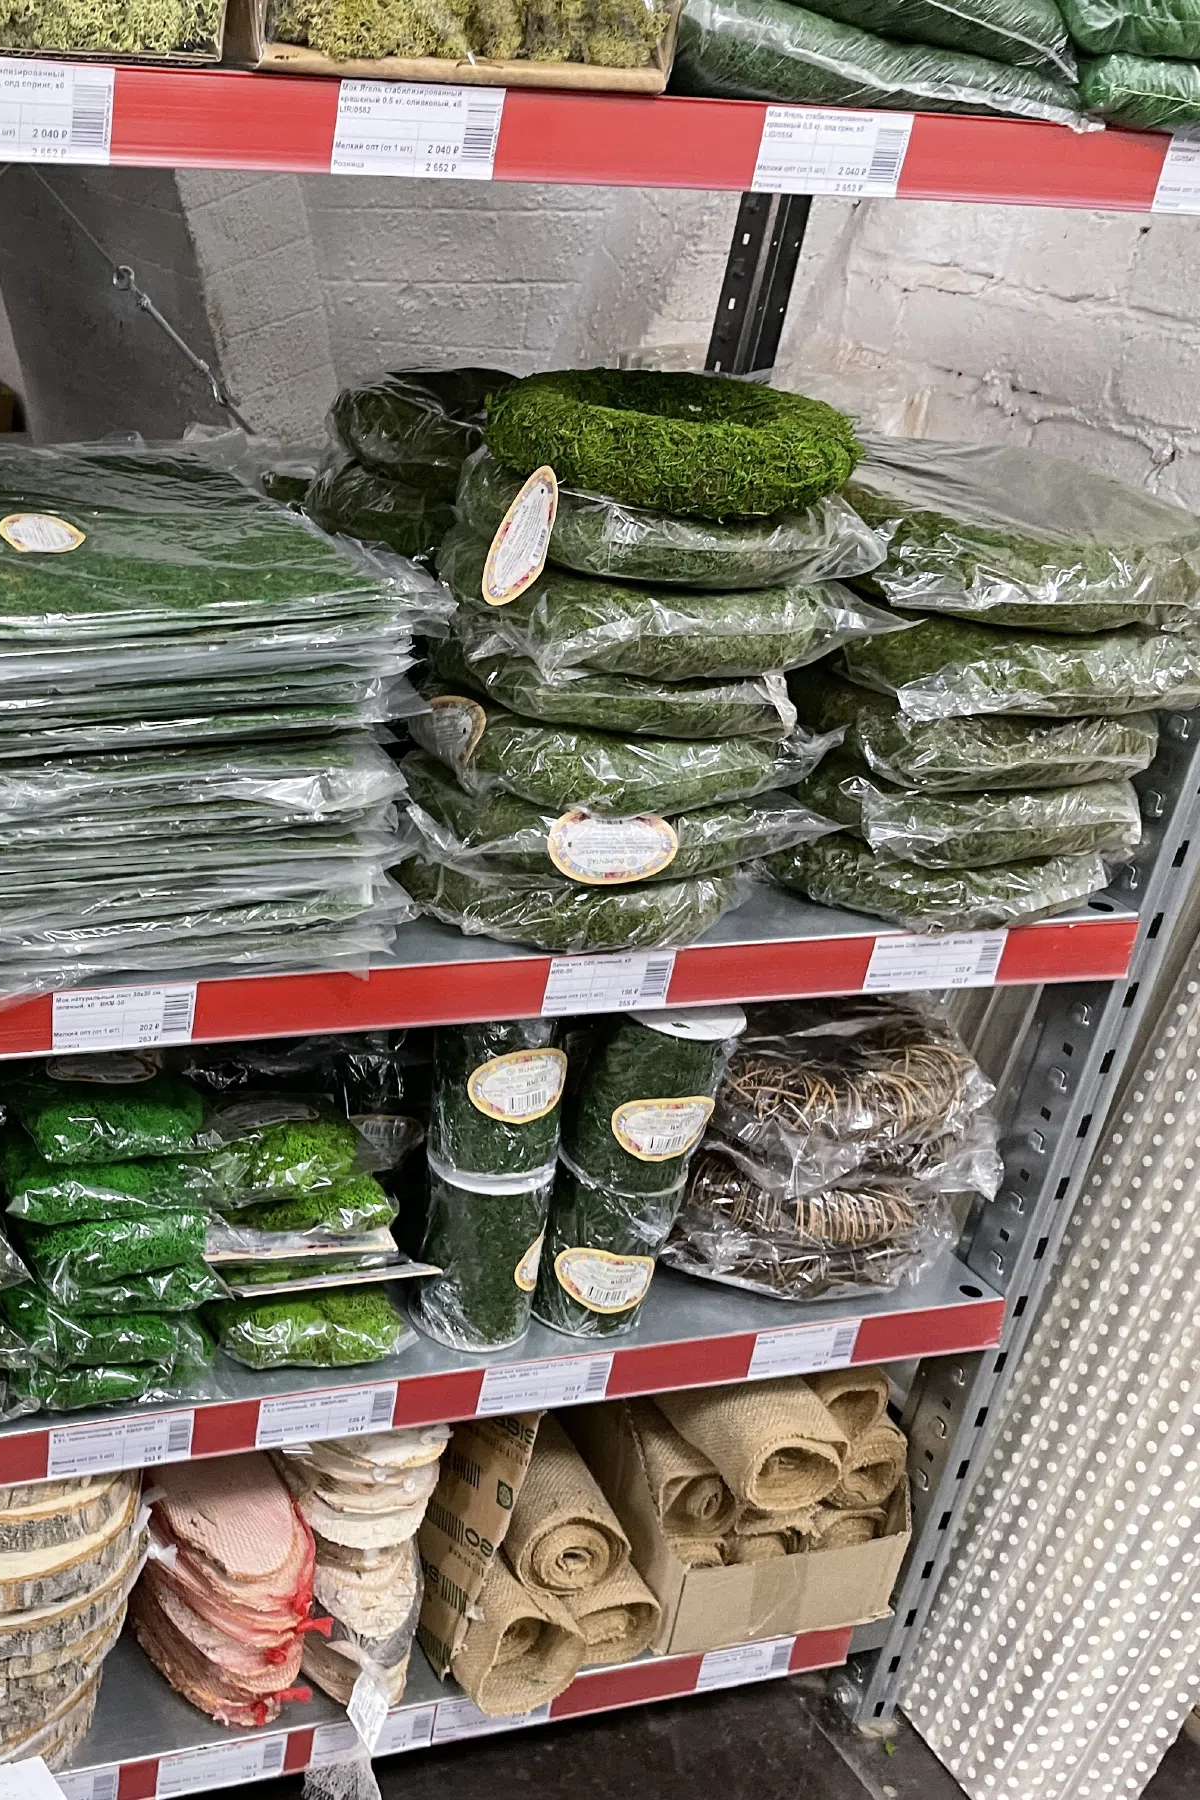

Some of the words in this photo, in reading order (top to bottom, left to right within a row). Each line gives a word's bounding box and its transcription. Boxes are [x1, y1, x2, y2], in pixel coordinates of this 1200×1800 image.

[342, 83, 358, 92] Мох
[385, 86, 462, 97] стабилизированный
[2, 128, 16, 137] шт)
[41, 129, 59, 139] 040
[335, 141, 363, 150] Мелкий
[365, 143, 378, 151] опт
[381, 143, 392, 152] (от
[400, 145, 413, 153] шт)
[435, 145, 451, 154] 040
[333, 160, 365, 168] Розница
[433, 163, 449, 172] 652
[845, 168, 860, 176] 040
[842, 184, 856, 192] 652
